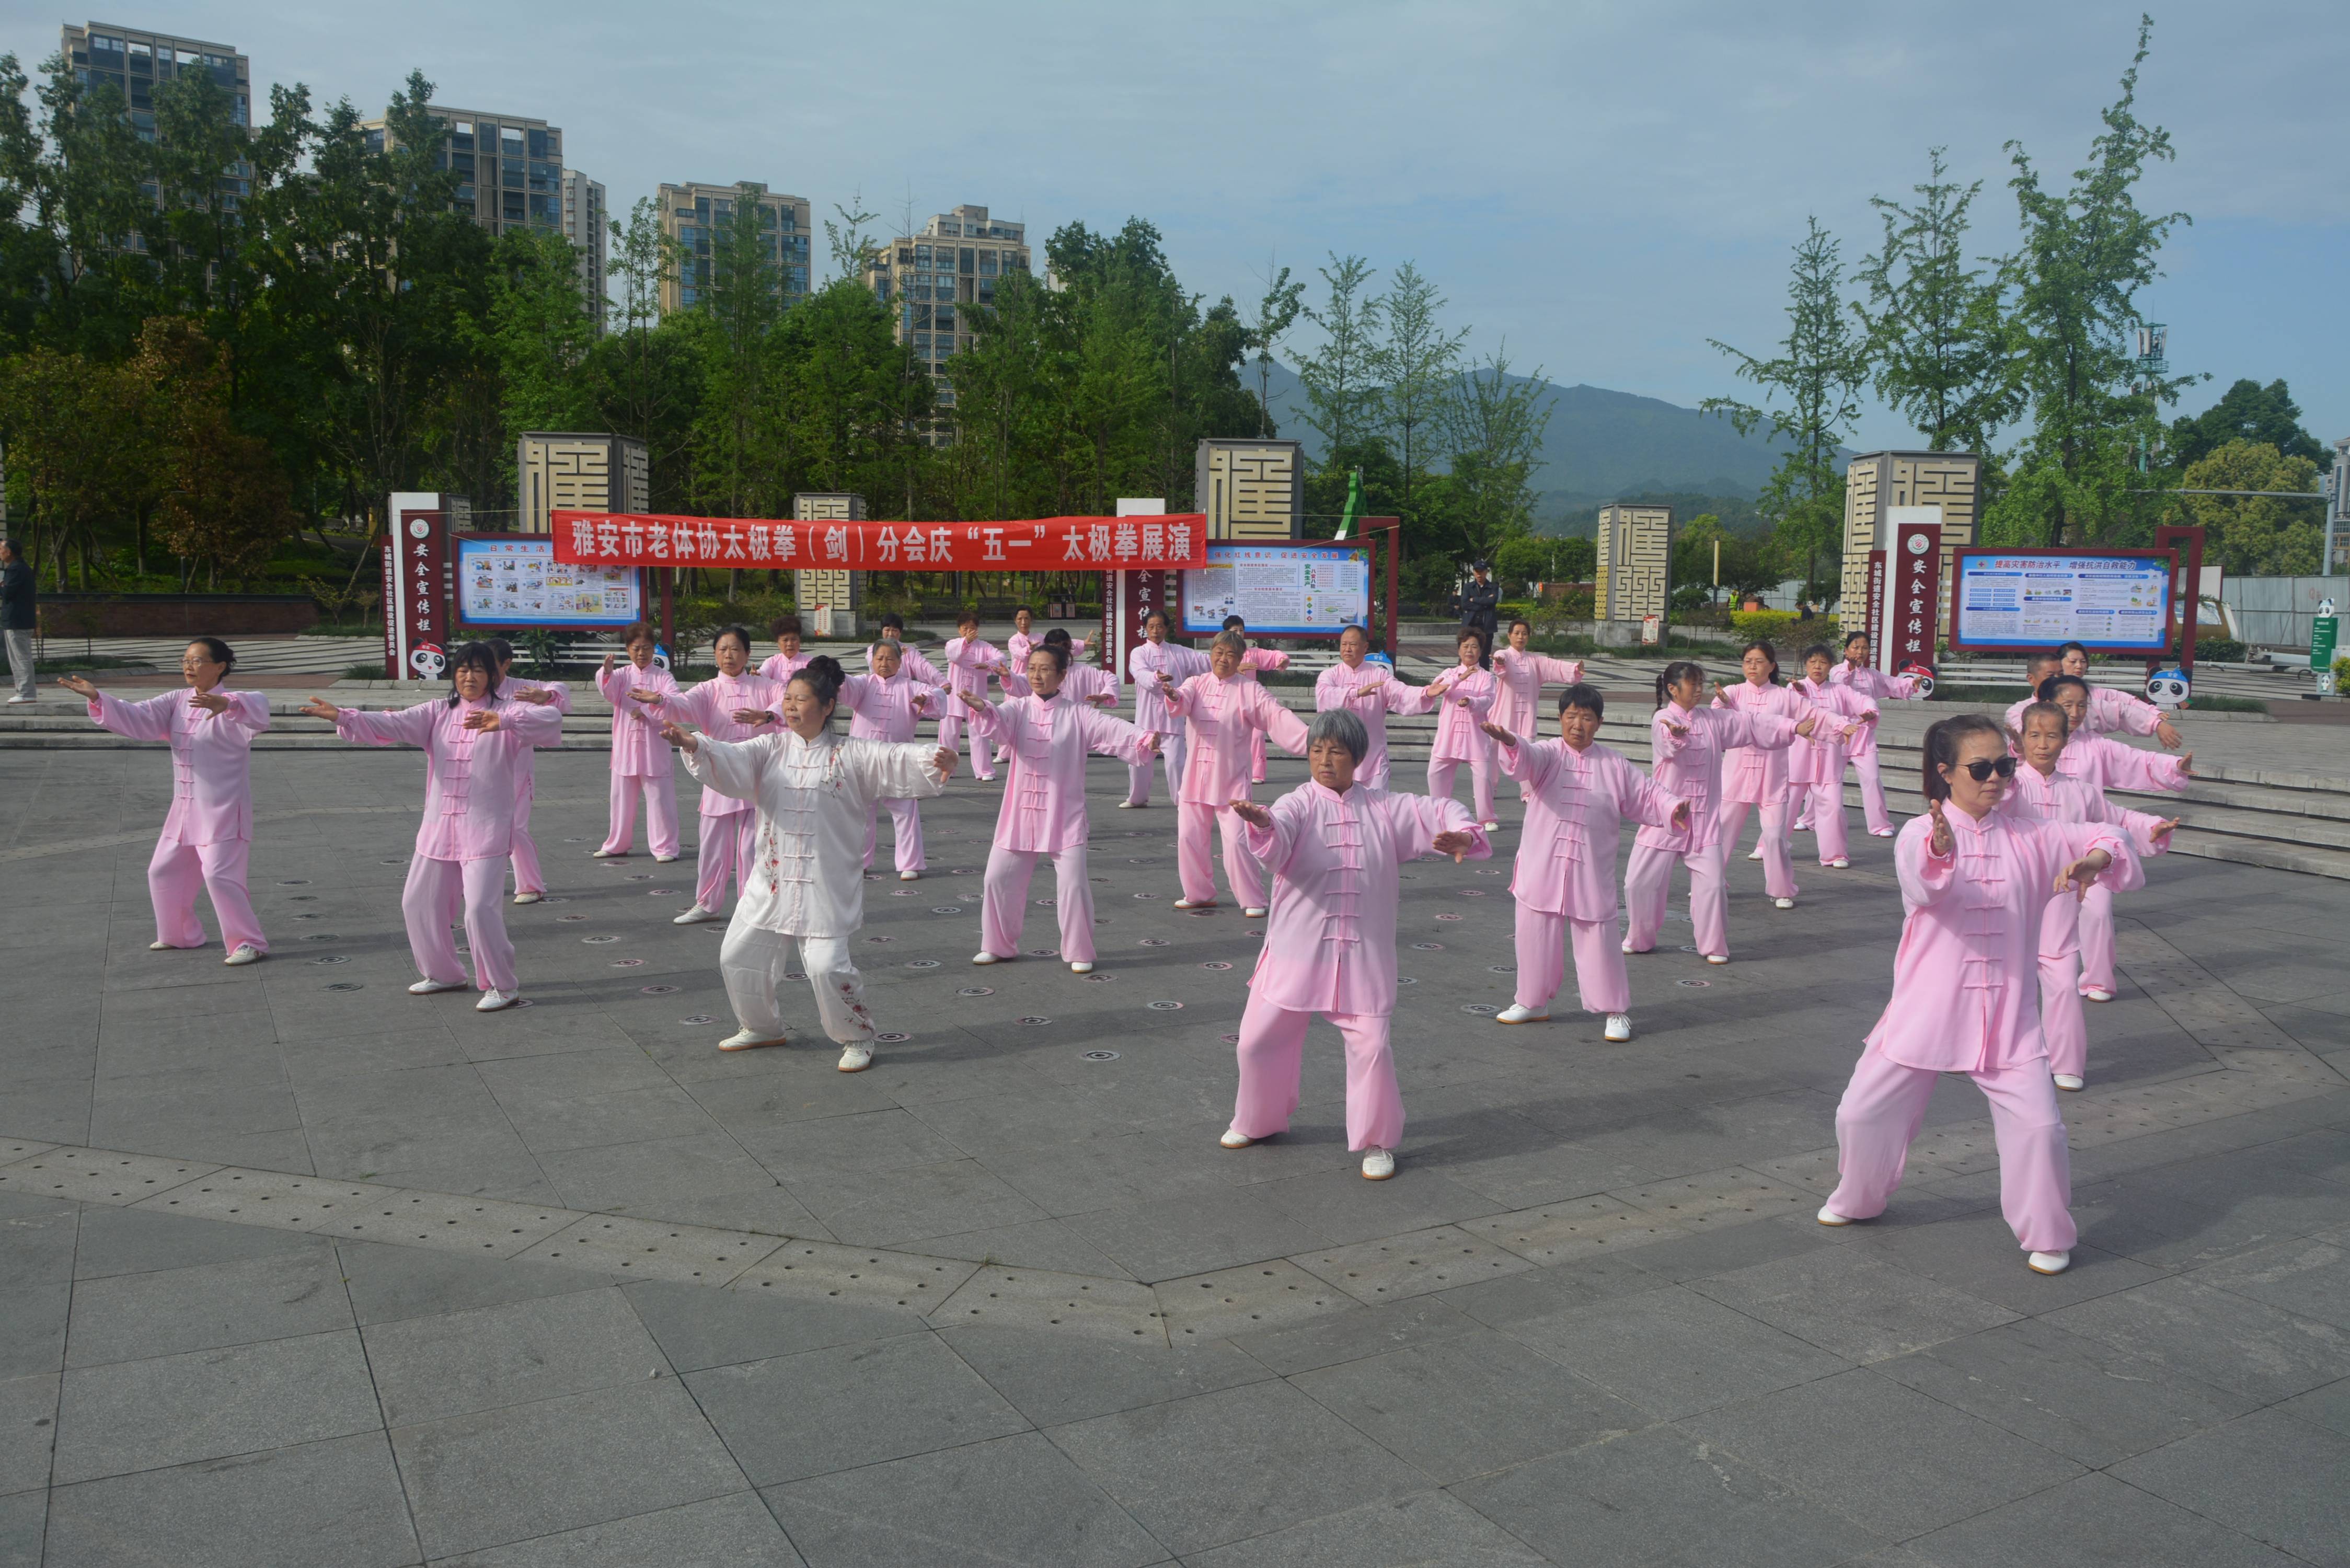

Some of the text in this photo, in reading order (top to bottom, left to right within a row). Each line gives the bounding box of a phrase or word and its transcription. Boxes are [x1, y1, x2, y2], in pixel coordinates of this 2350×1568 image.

[384, 545, 396, 656] 东城街道安全社区建设促进委员会
[413, 543, 431, 631] 安全宣传栏
[1905, 559, 1927, 653] 安全宣传栏
[1994, 560, 2136, 570] 提高灾害防治水平 增强抗洪自救能力
